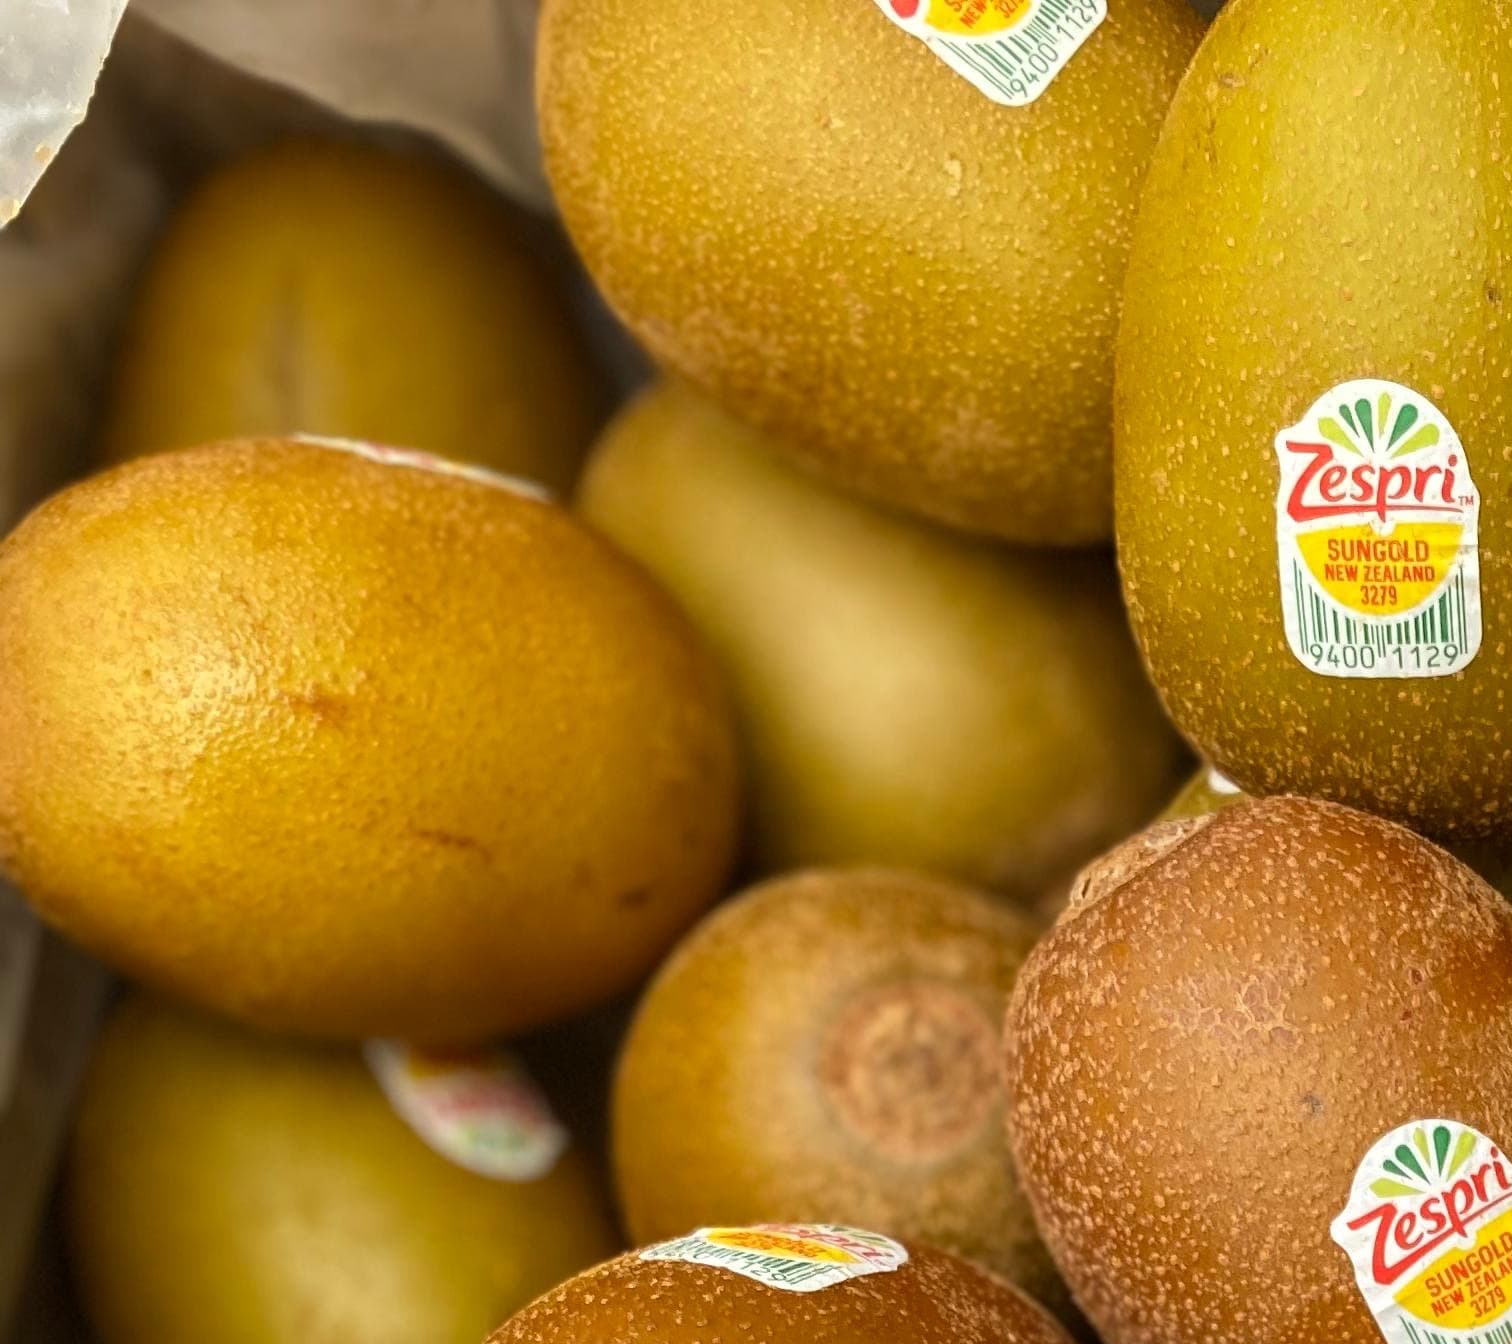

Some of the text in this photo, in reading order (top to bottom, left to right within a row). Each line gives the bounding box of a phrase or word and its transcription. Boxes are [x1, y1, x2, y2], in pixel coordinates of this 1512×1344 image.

[1010, 41, 1058, 97] 9400
[1286, 440, 1464, 523] Zespri
[1327, 539, 1430, 562] SUNGOLD
[1325, 564, 1435, 582] NEW ZEALAND
[1360, 586, 1398, 606] 3279
[1310, 643, 1459, 669] 9400 1129
[1430, 1290, 1465, 1317] NEW
[1469, 1287, 1507, 1318] 3279
